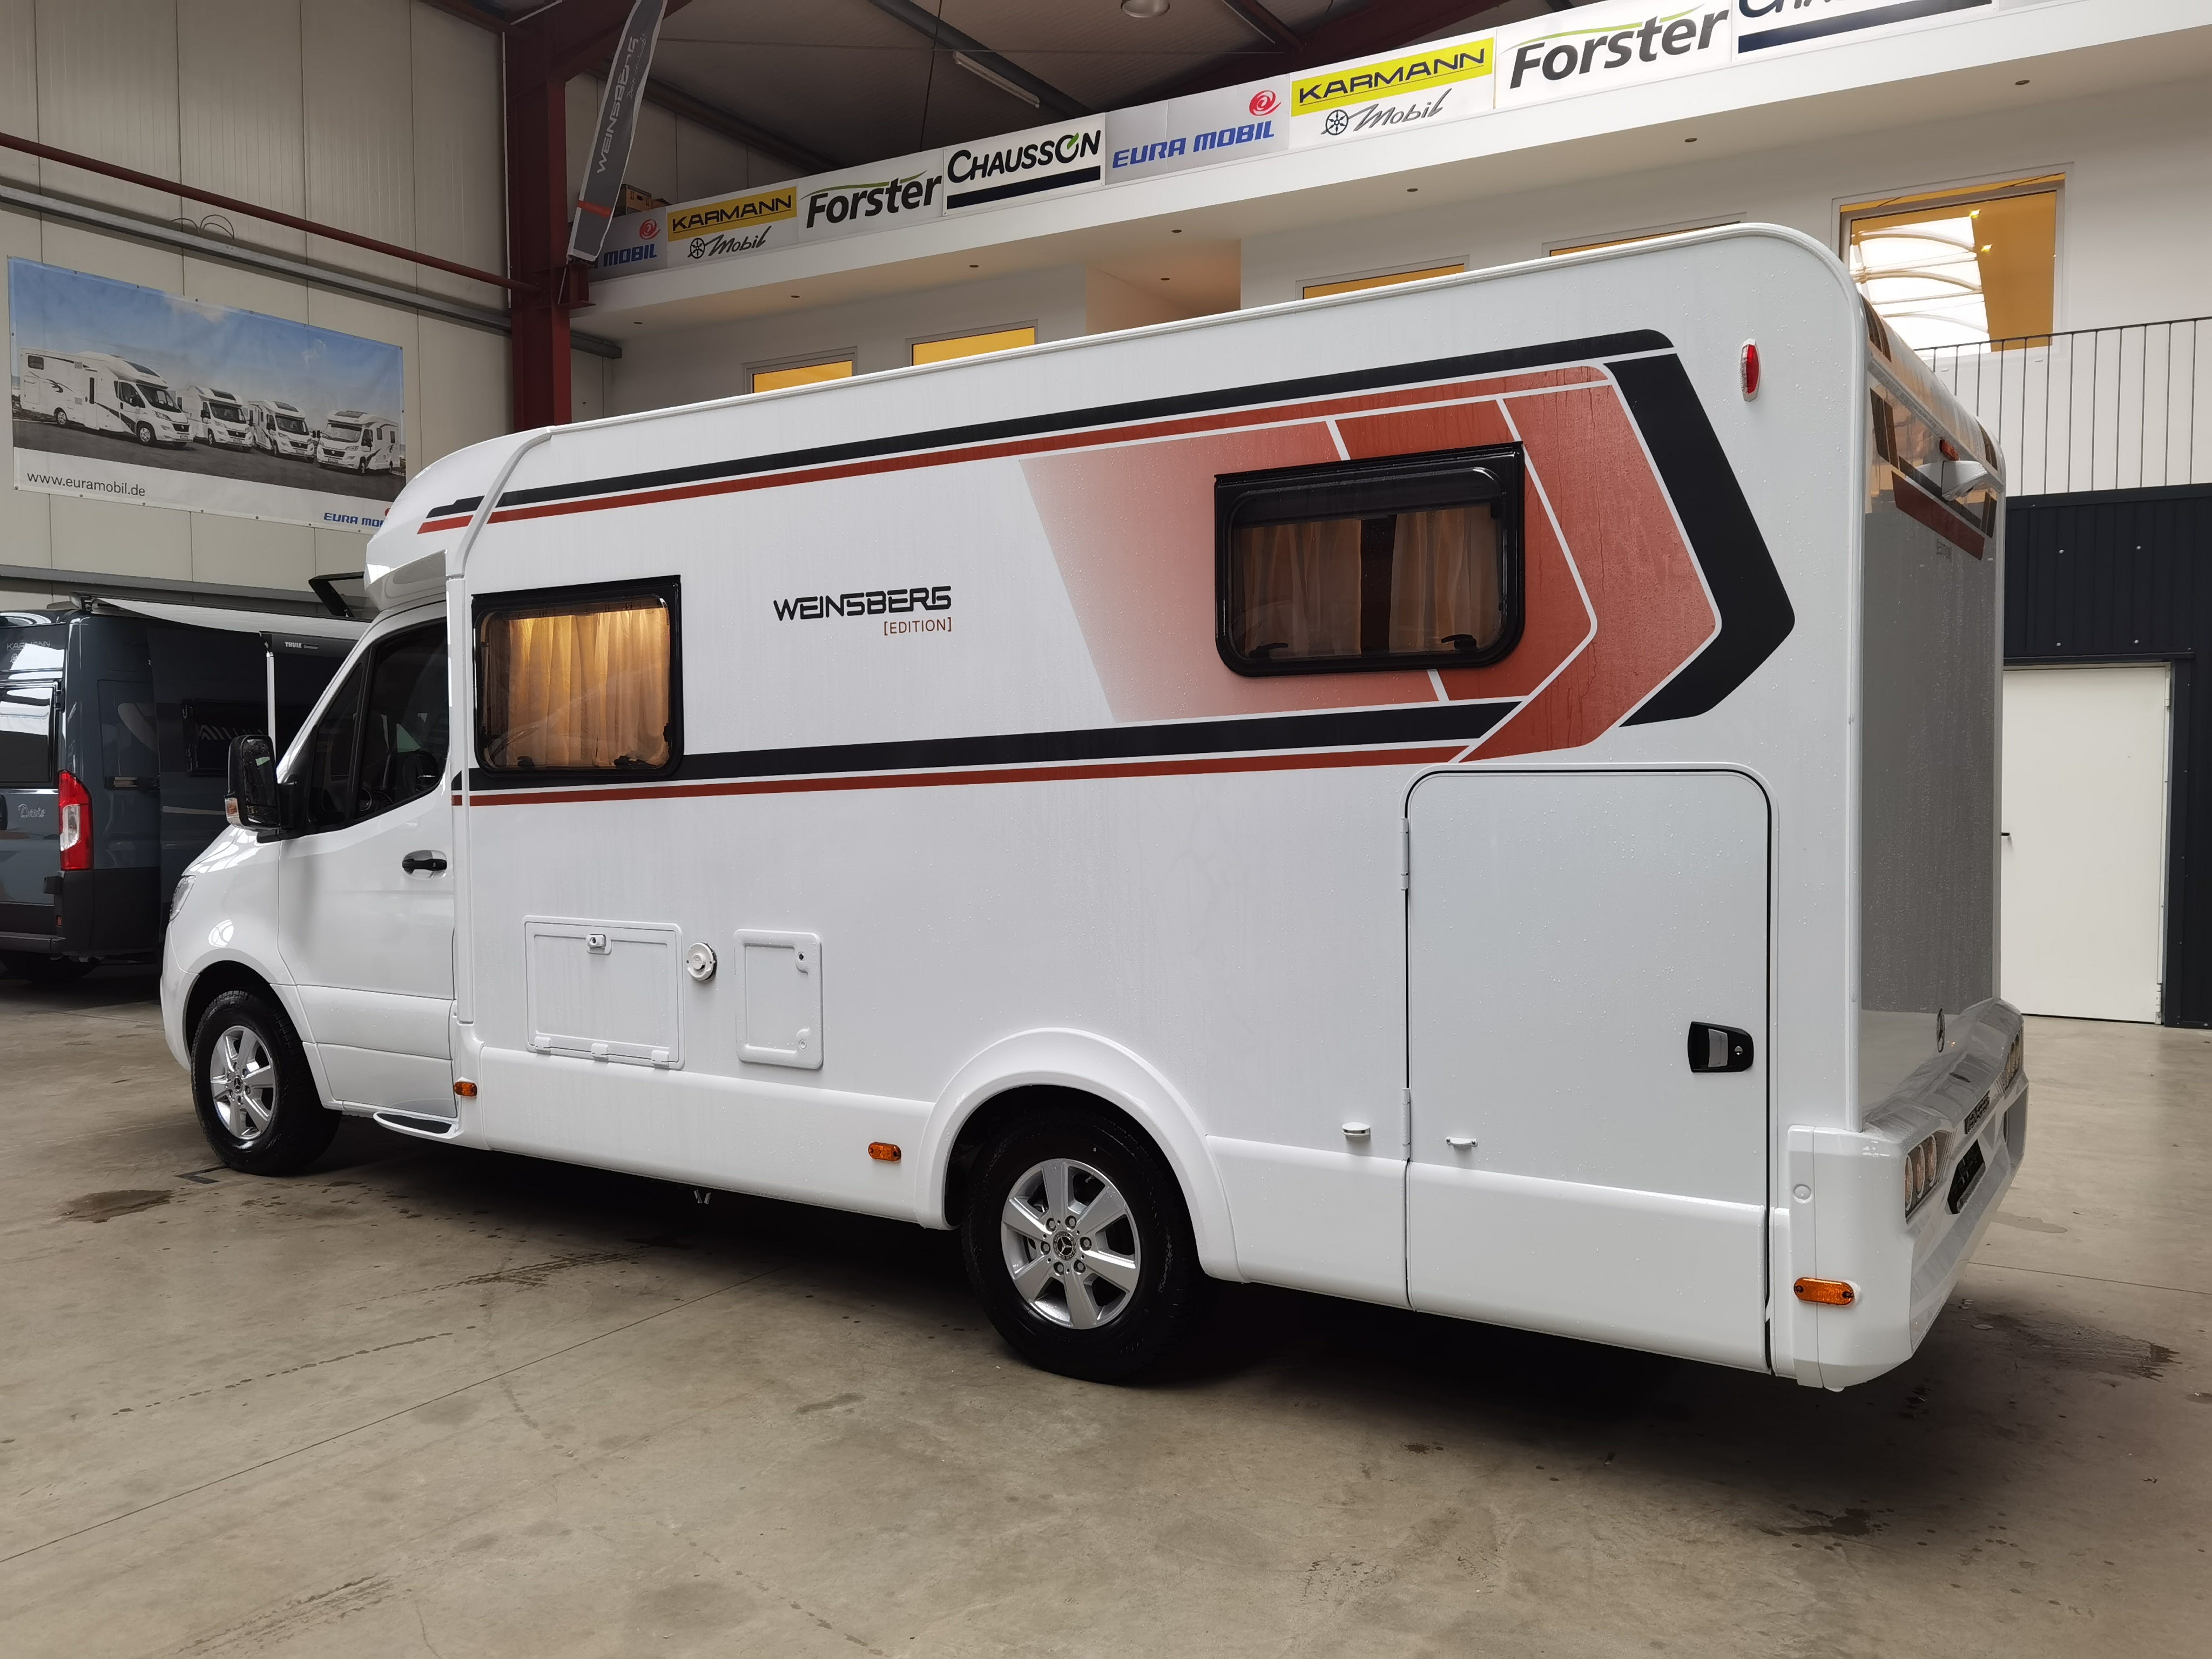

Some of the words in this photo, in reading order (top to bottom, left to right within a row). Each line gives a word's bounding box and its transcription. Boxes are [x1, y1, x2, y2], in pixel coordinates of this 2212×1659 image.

[1509, 9, 1730, 90] Forster
[1299, 48, 1485, 104] KARMANN
[1348, 87, 1452, 132] Mobil
[947, 130, 1102, 183] CHAUSSON
[1112, 137, 1187, 168] EURA
[1192, 120, 1275, 152] MOBIL
[672, 194, 792, 231] KARMANN
[806, 175, 942, 228] Forster
[603, 244, 657, 267] MOBIL
[705, 225, 772, 257] Mobil
[27, 473, 146, 496] www.euramobil.de
[323, 512, 359, 525] EURA
[773, 585, 952, 621] WEINSBERG
[884, 617, 952, 636] [EDITION]
